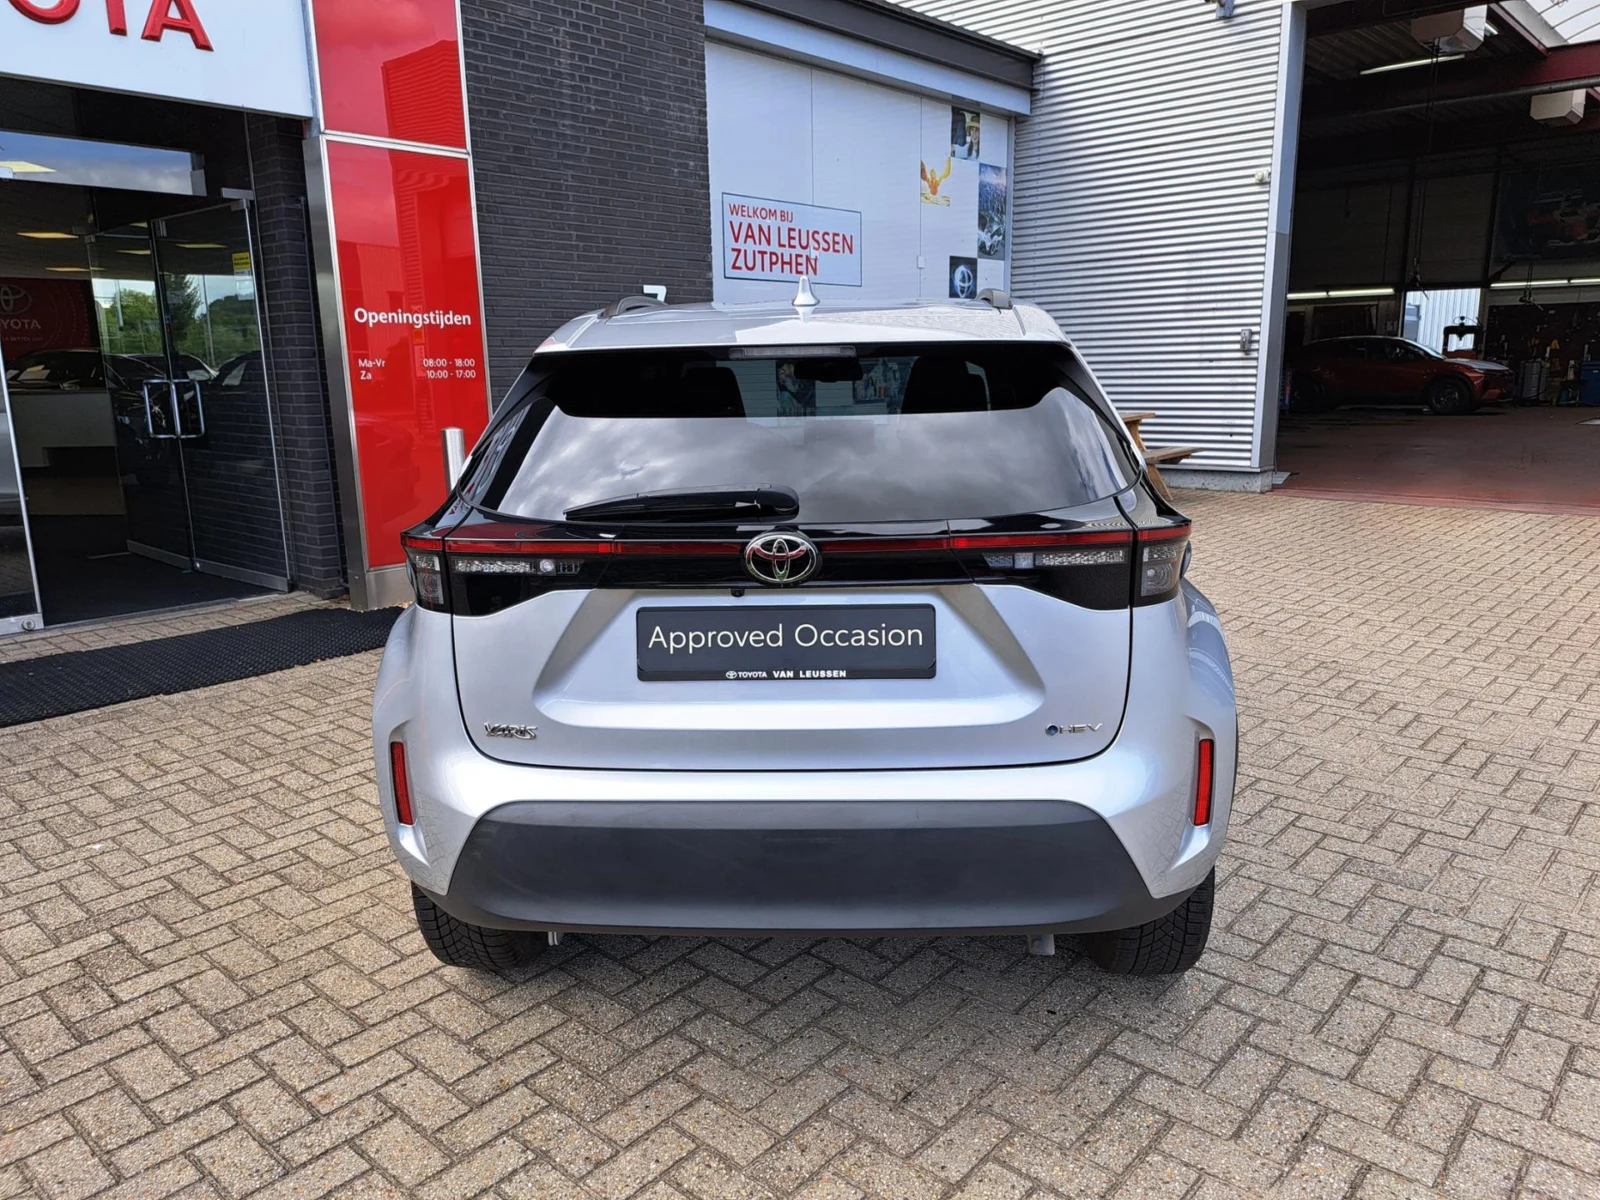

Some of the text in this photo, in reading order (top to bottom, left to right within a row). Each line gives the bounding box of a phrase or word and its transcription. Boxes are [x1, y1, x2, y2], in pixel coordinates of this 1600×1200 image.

[728, 203, 794, 223] WELKOM BIJ
[729, 220, 854, 255] VAN LEUSSEN
[730, 247, 818, 276] ZUTPHEN
[354, 307, 471, 329] Openingstijden
[358, 358, 385, 368] Ma-Vr
[422, 358, 447, 368] 08:00
[454, 358, 475, 368] 18:00
[360, 371, 372, 380] Za
[426, 370, 448, 379] 10:00
[455, 370, 476, 379] 17:00
[648, 623, 923, 654] Approved Occasion
[738, 670, 847, 679] TOYOTA VAN LEUSSEN
[1059, 723, 1103, 734] HEV
